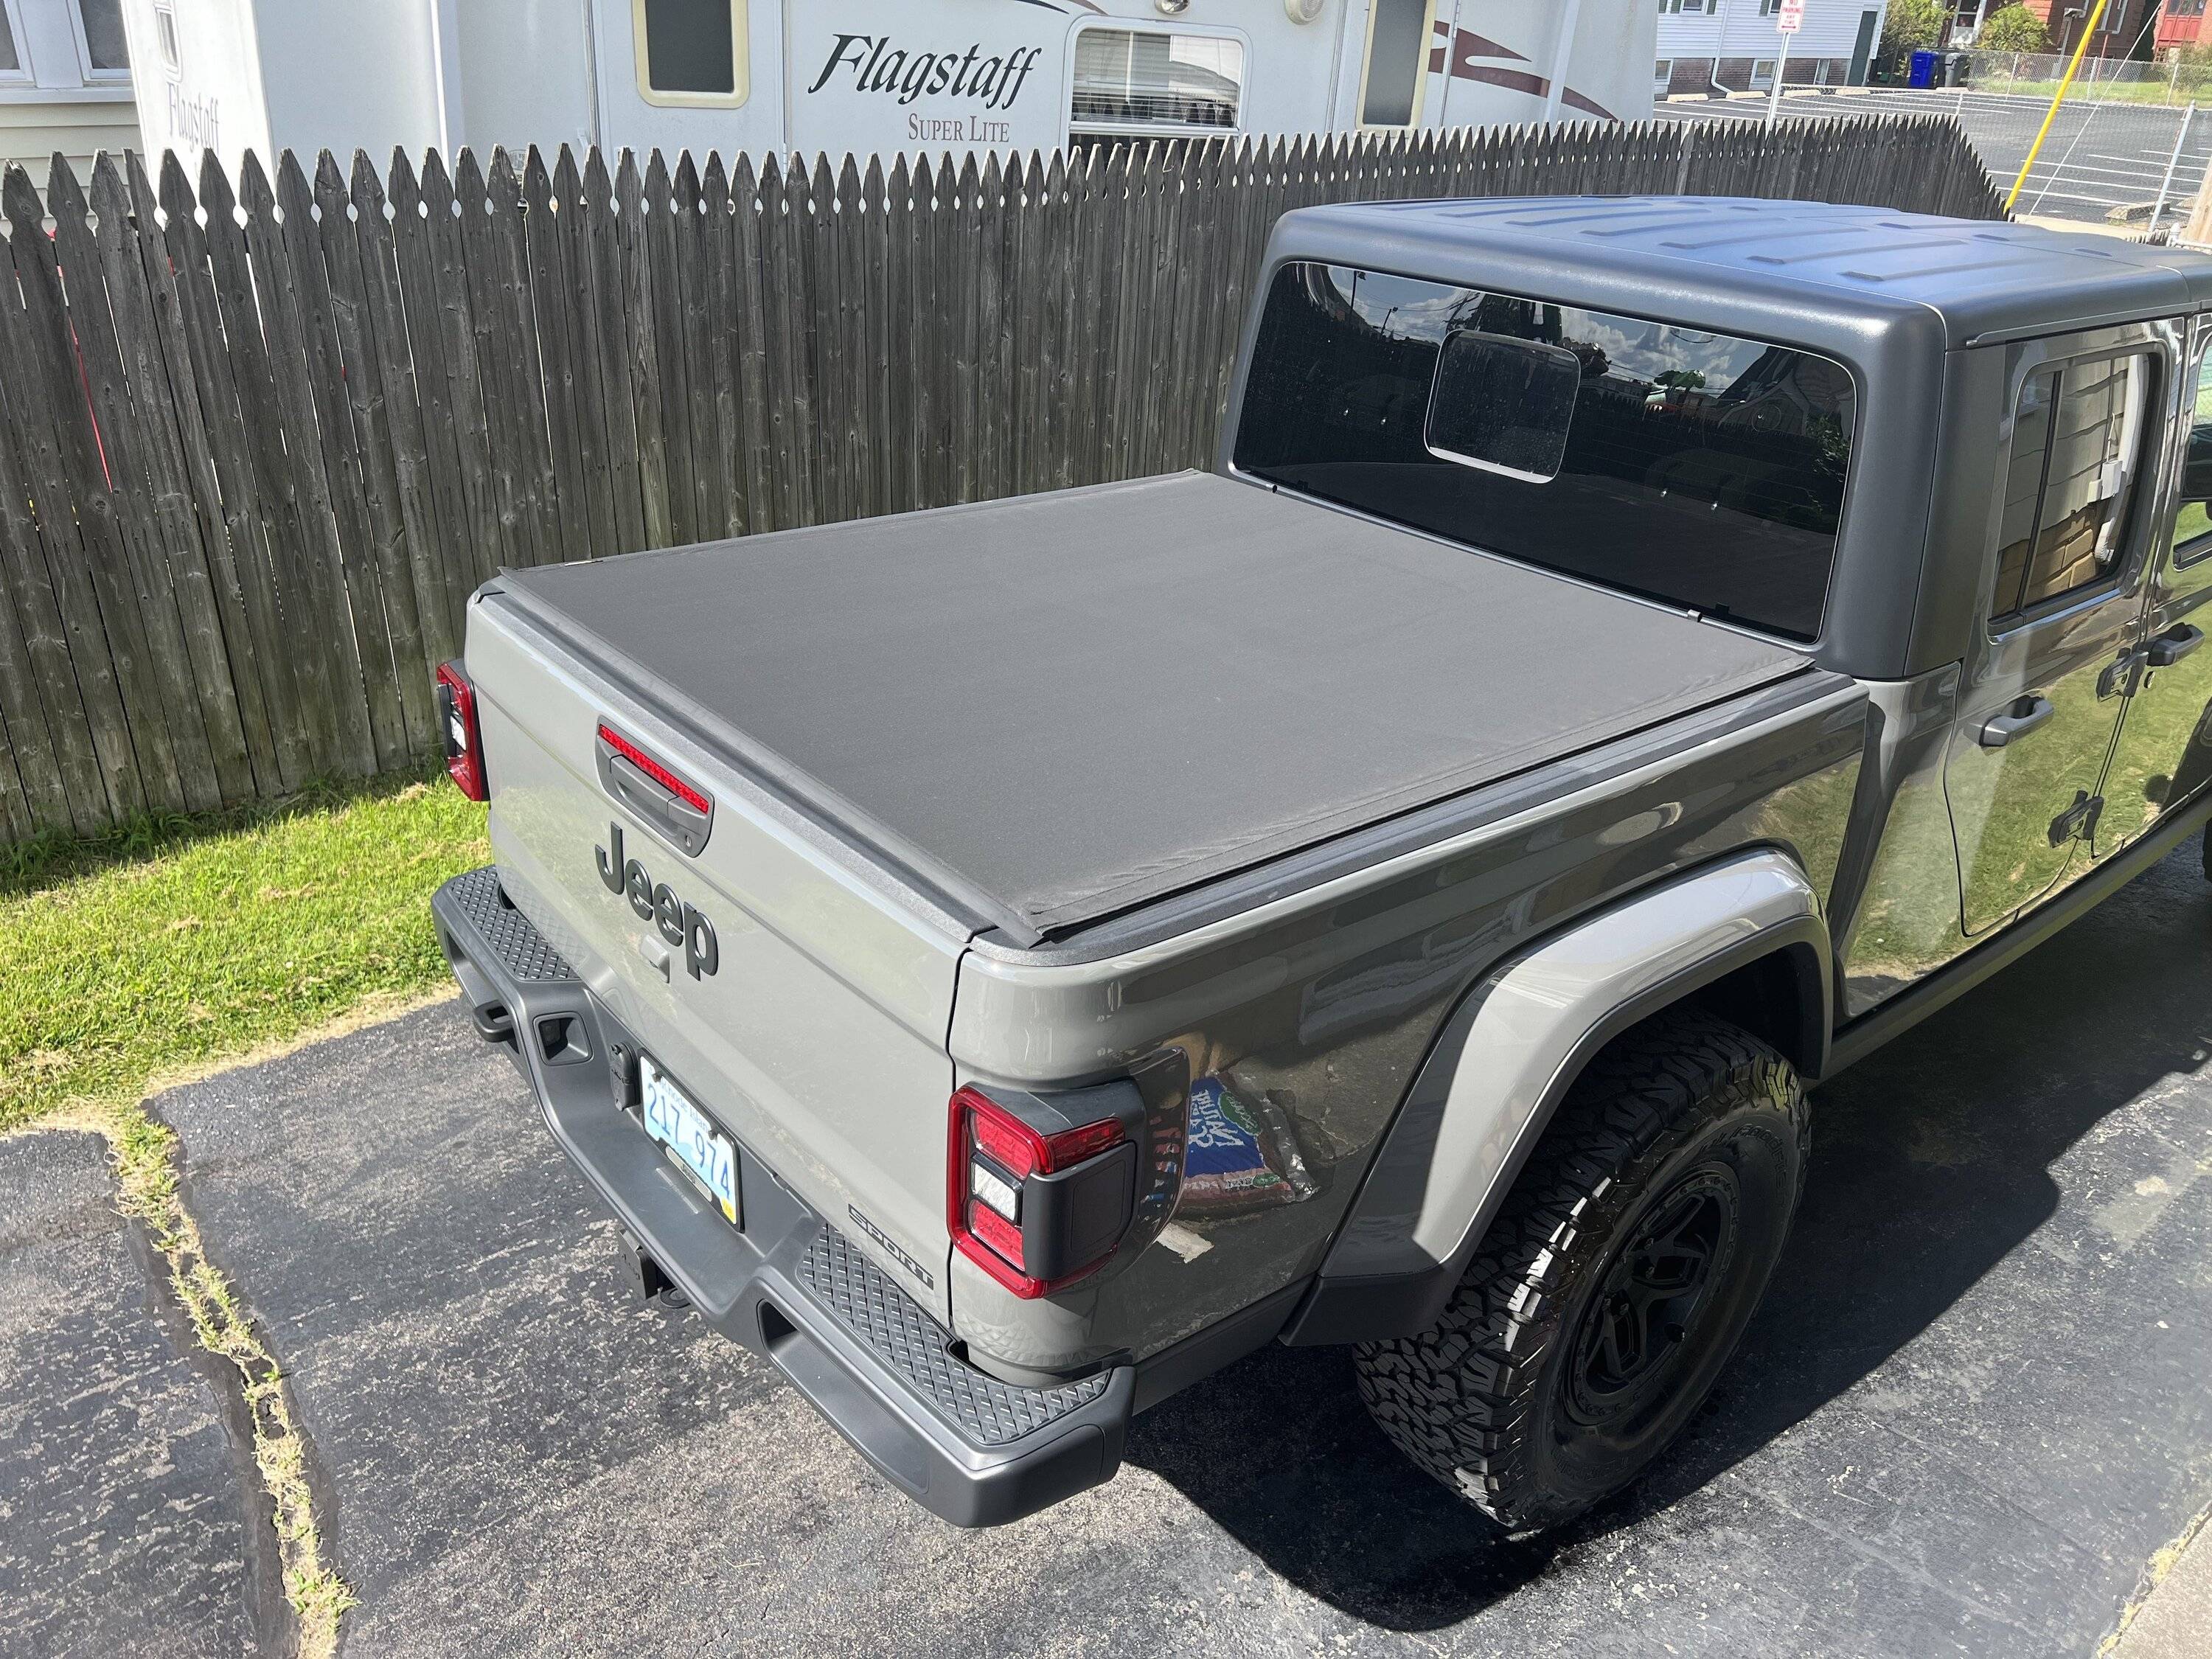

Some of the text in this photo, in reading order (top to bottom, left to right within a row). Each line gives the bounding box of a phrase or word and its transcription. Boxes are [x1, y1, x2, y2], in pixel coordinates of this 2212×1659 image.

[807, 33, 1042, 110] Flagstaff
[166, 81, 219, 158] Flagstaff
[908, 113, 1009, 143] SUPER LITE
[594, 821, 719, 981] Jeep
[648, 1082, 680, 1145] 217
[695, 1130, 730, 1200] 974
[689, 1105, 709, 1134] Islan
[848, 1203, 934, 1290] SPORT
